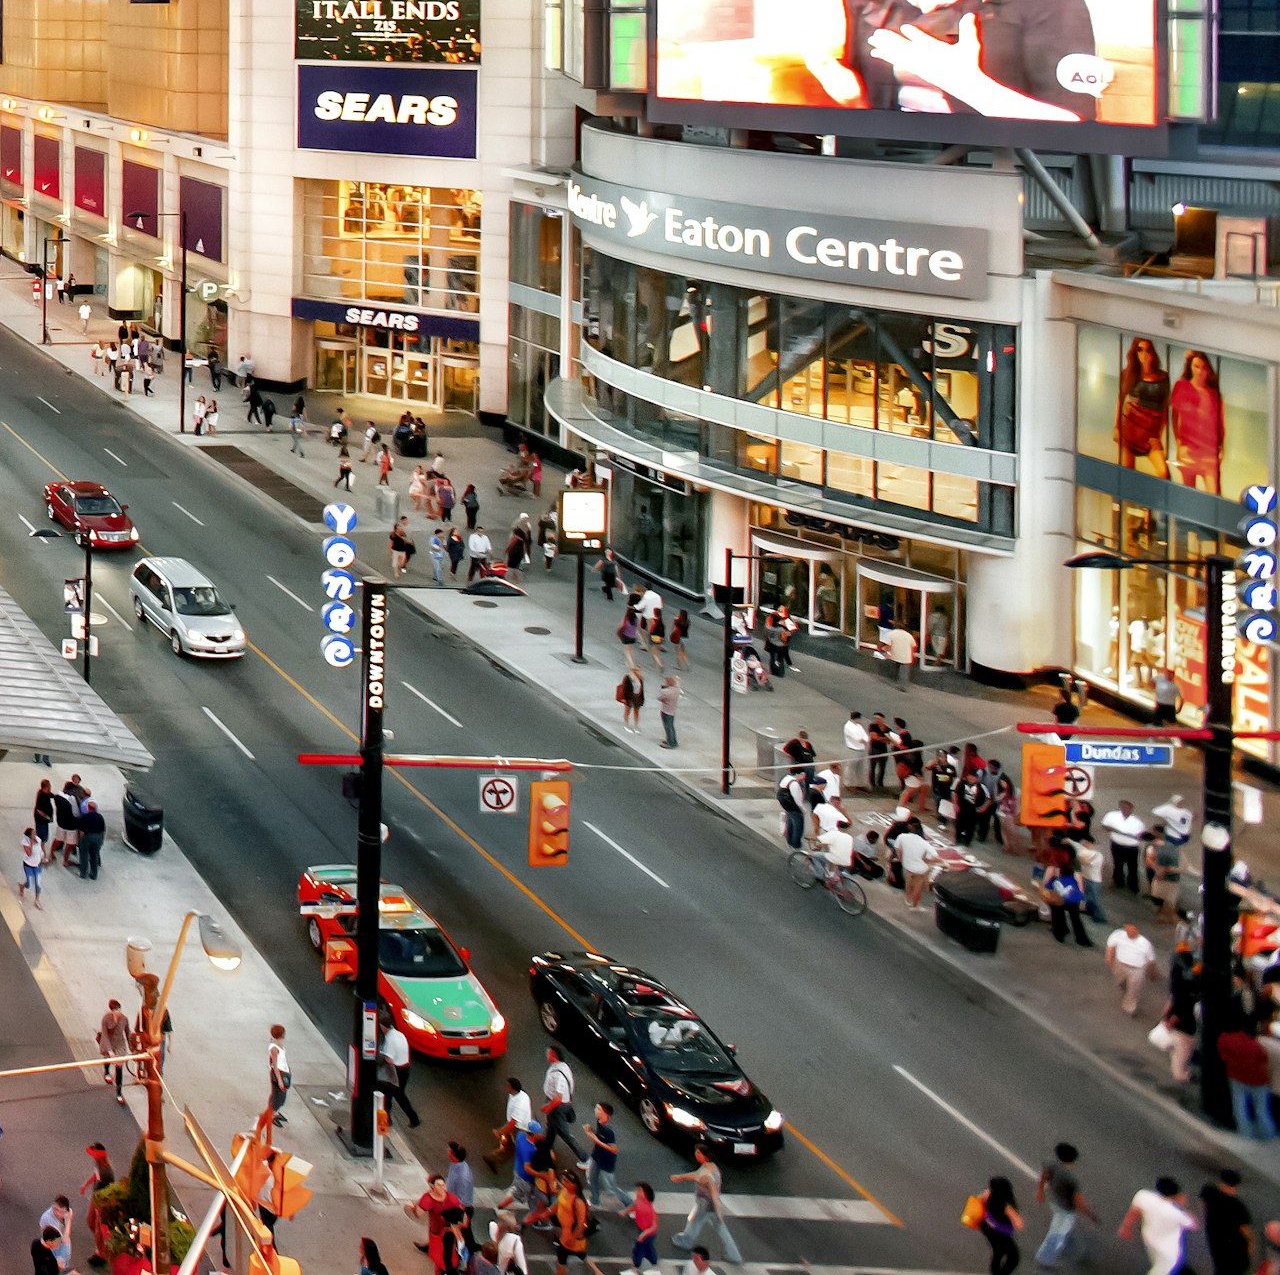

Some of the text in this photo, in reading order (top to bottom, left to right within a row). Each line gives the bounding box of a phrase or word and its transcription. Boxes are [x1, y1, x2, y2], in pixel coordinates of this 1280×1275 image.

[312, 1, 460, 21] IT ALL ENDS
[314, 91, 459, 126] SEARS
[665, 208, 770, 258] Eaton
[786, 226, 964, 281] Centre
[203, 285, 218, 299] P
[345, 307, 420, 331] SEARS
[321, 502, 357, 668] Yonge
[1244, 485, 1278, 645] Yonge
[369, 593, 386, 710] DOWNTOWN
[1221, 570, 1236, 684] DOWNTOWN
[1081, 743, 1140, 761] Dundas
